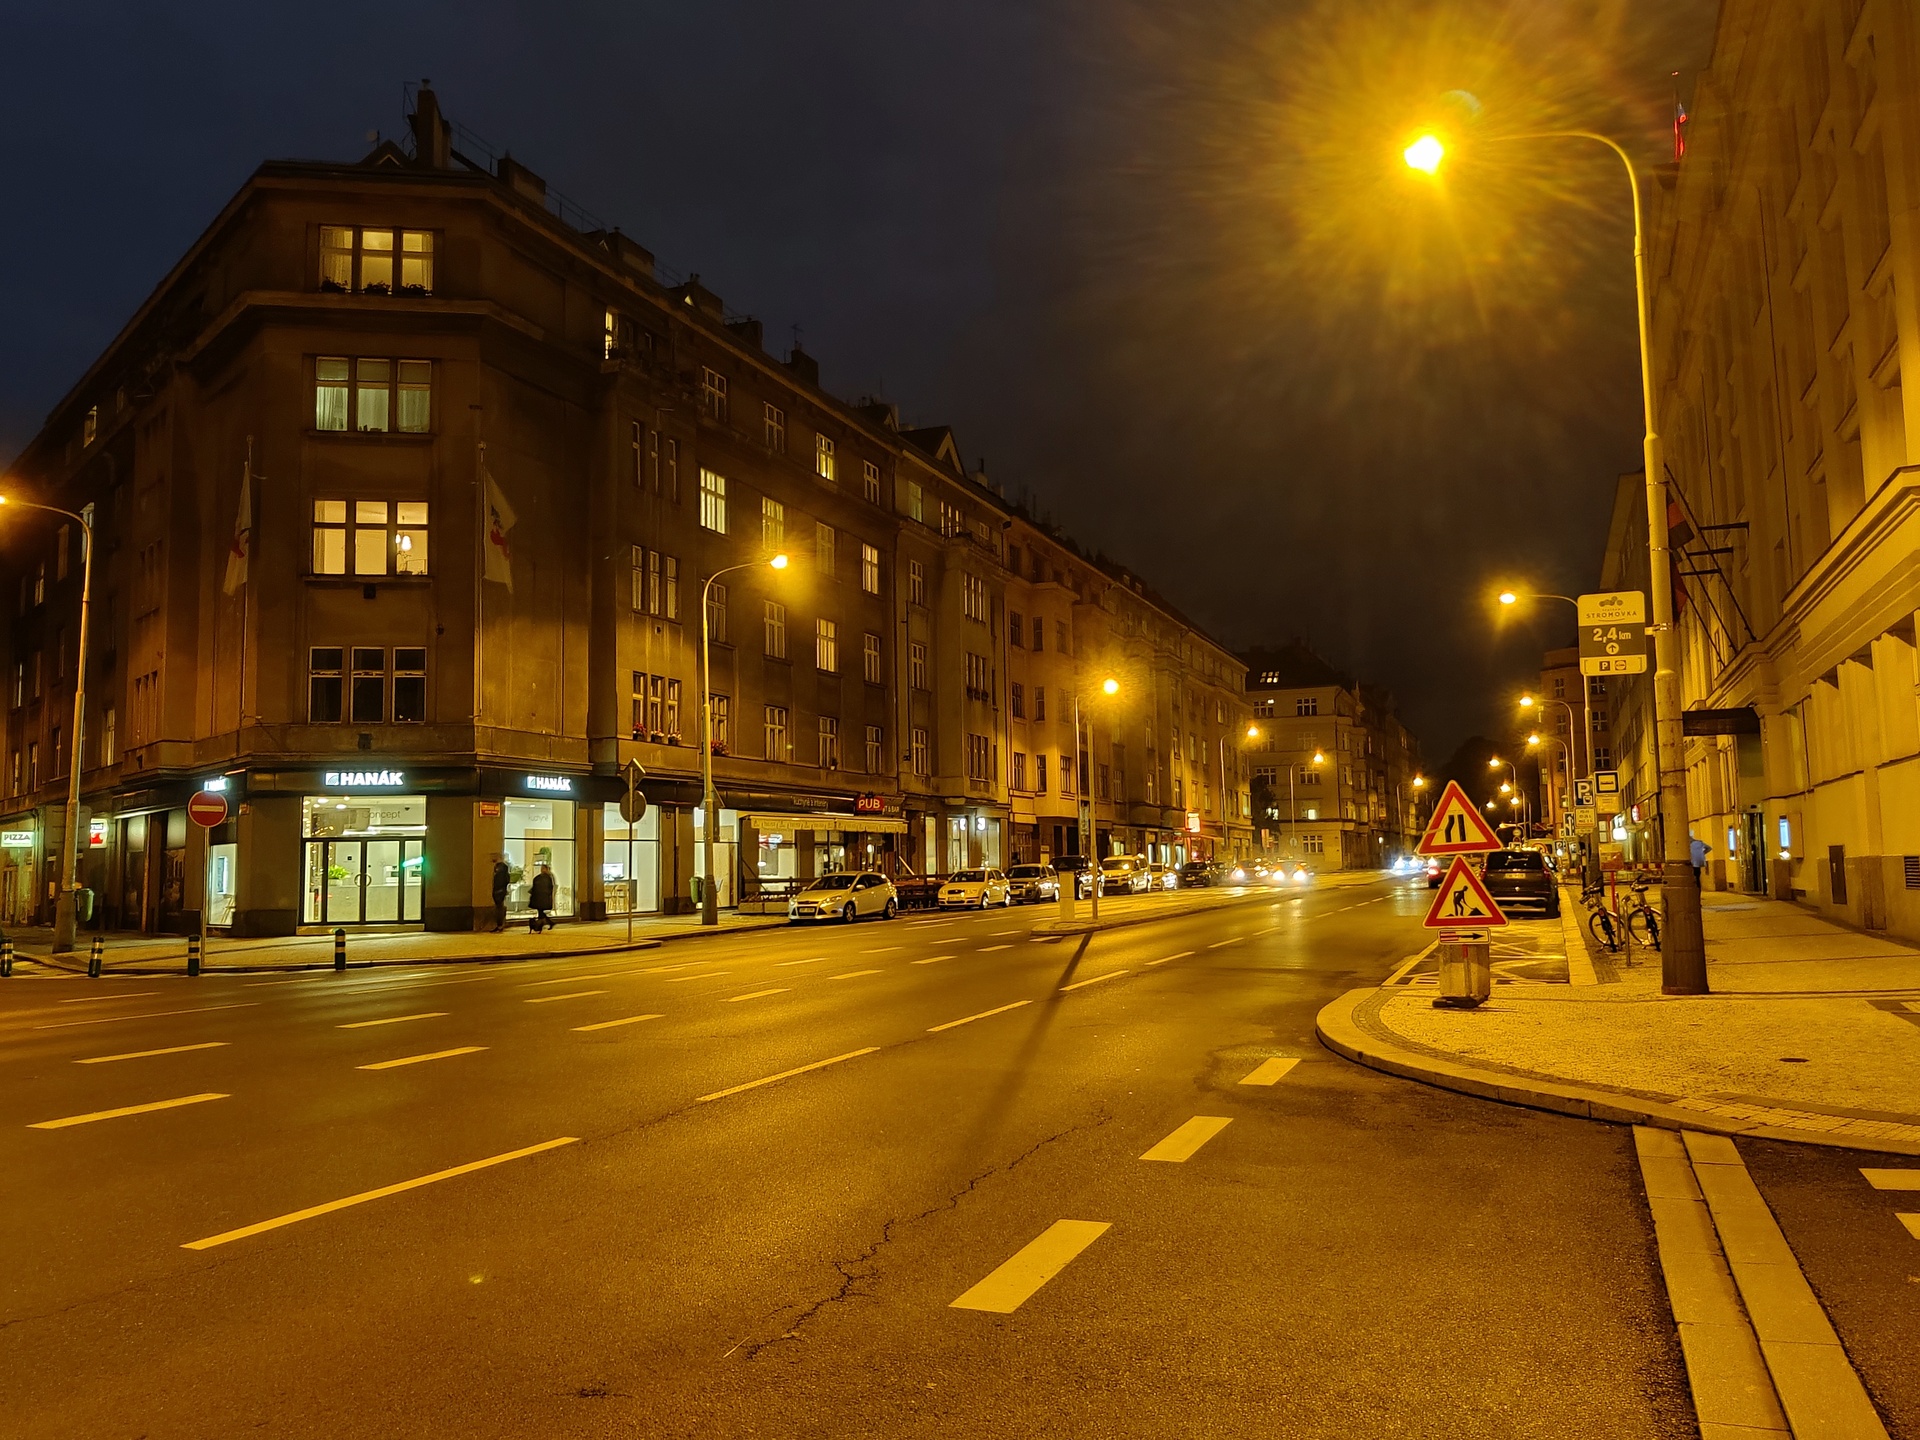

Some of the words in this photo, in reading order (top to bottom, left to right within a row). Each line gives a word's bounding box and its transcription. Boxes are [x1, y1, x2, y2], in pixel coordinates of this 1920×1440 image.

[1586, 611, 1637, 619] STROMOVKA
[1593, 627, 1617, 643] 2,4
[1618, 631, 1631, 640] km
[340, 770, 404, 786] HANÁK
[536, 776, 571, 791] HANÁK
[858, 799, 881, 809] PUB
